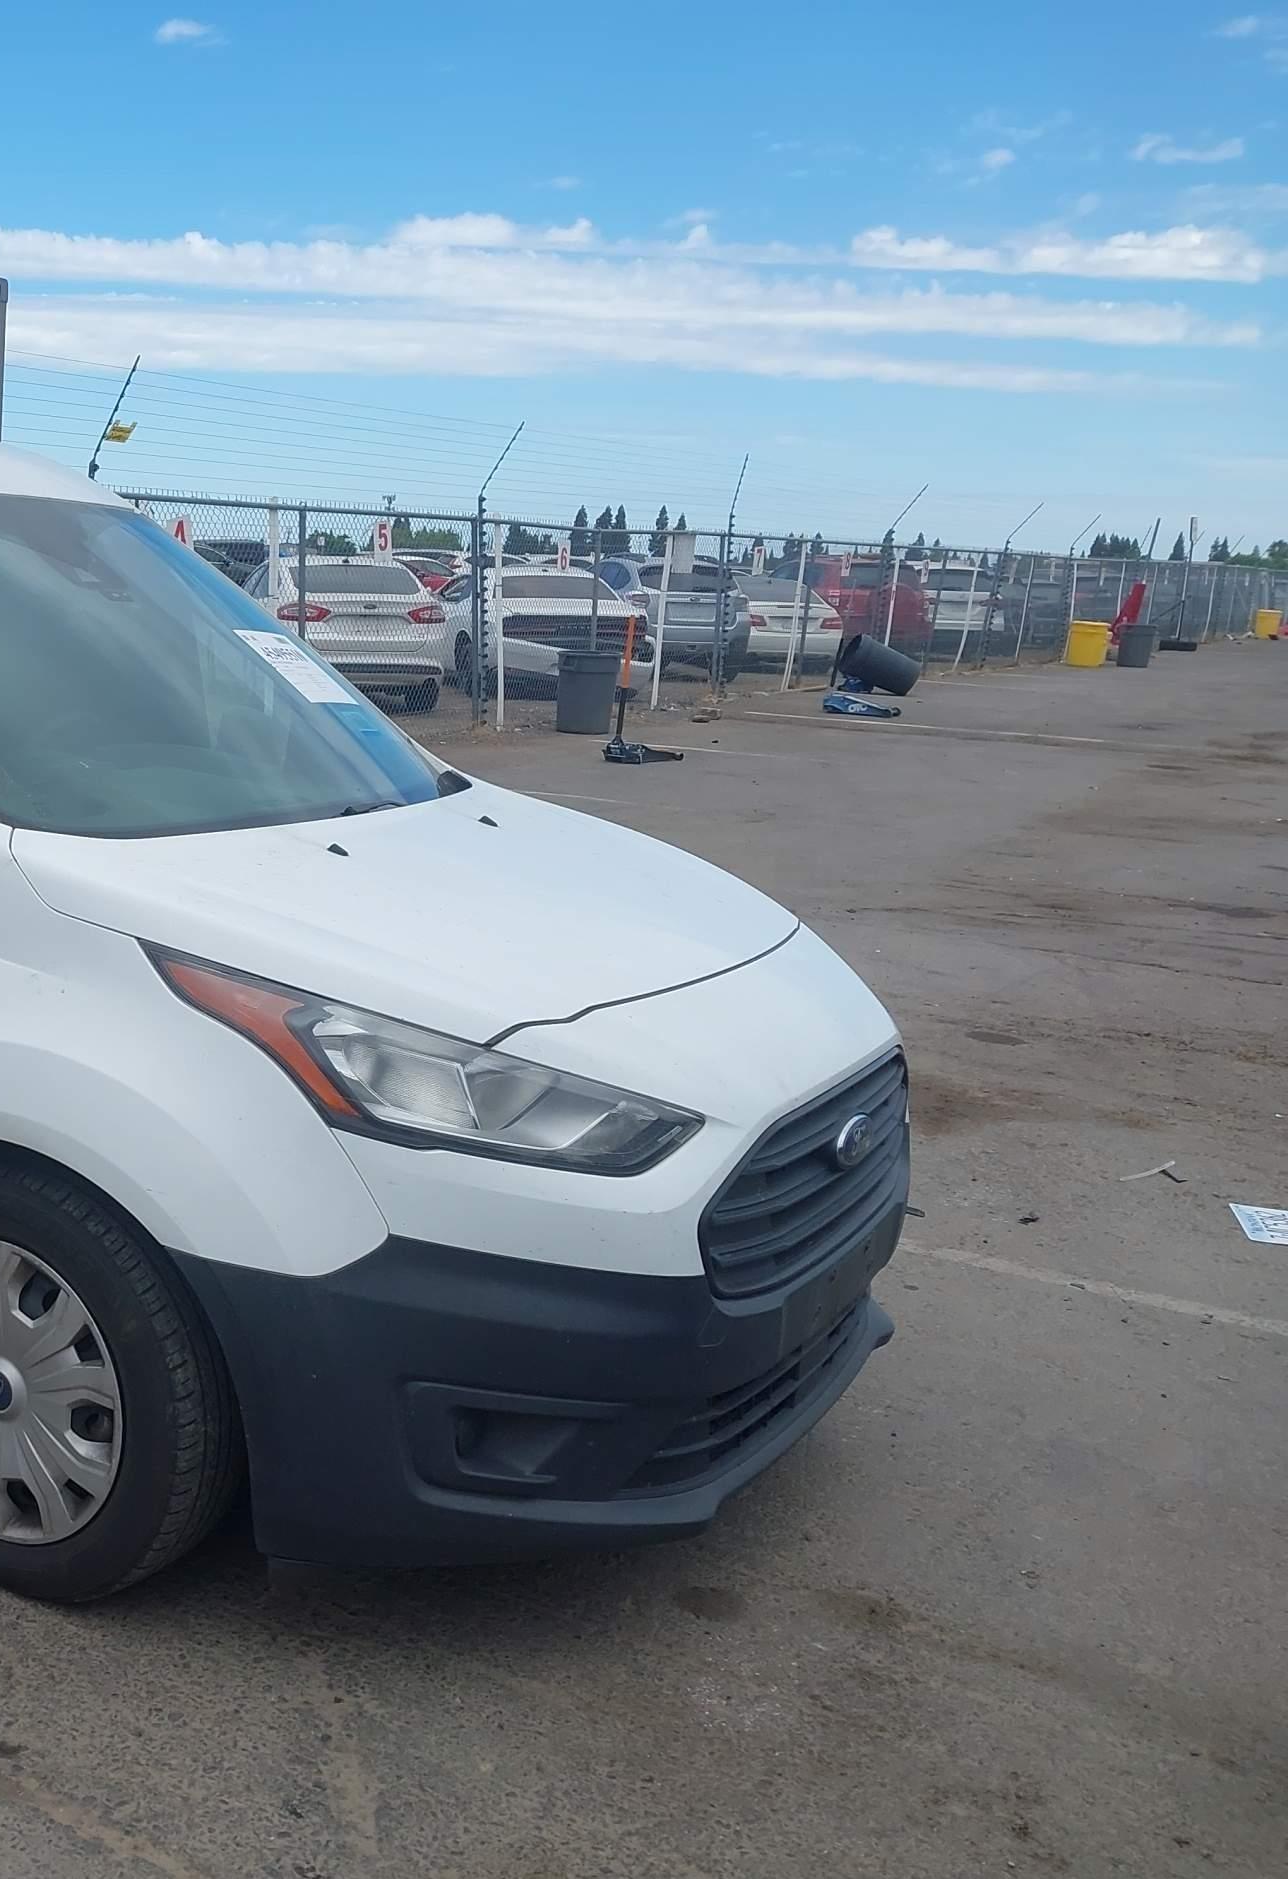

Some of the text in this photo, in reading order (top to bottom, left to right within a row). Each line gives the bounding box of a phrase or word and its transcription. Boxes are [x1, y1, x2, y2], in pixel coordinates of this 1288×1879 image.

[378, 523, 388, 552] 5
[560, 546, 568, 570] 6
[756, 548, 763, 569] 7
